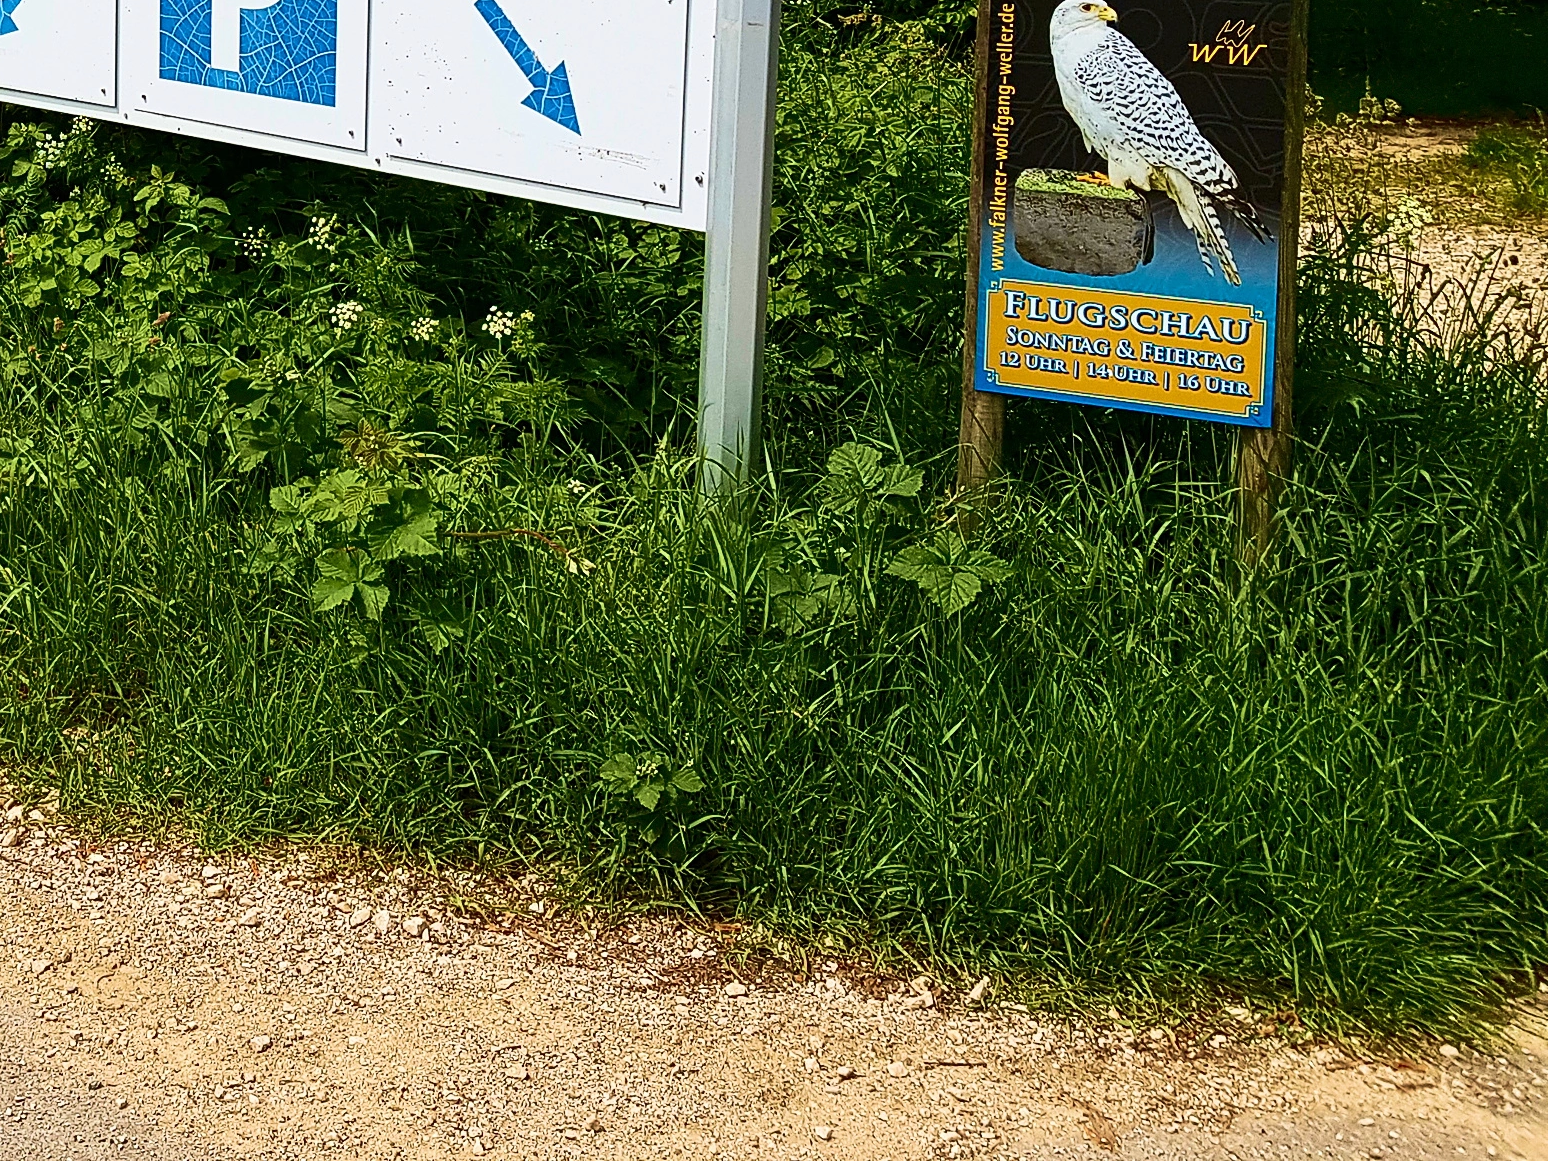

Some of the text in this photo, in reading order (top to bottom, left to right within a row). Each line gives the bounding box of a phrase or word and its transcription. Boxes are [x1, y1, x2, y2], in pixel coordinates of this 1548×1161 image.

[989, 3, 1015, 271] www.falkner-wolfgang-weller.de
[1004, 290, 1250, 344] FLUGSCHAU
[1000, 352, 1020, 367] 12
[1026, 354, 1068, 373] UHR
[1088, 362, 1108, 378] 14
[1114, 365, 1157, 385] UHR
[1178, 374, 1199, 389] 16
[1206, 377, 1251, 396] UHR
[1006, 326, 1244, 373] SONNTAG & FEIERTAG
